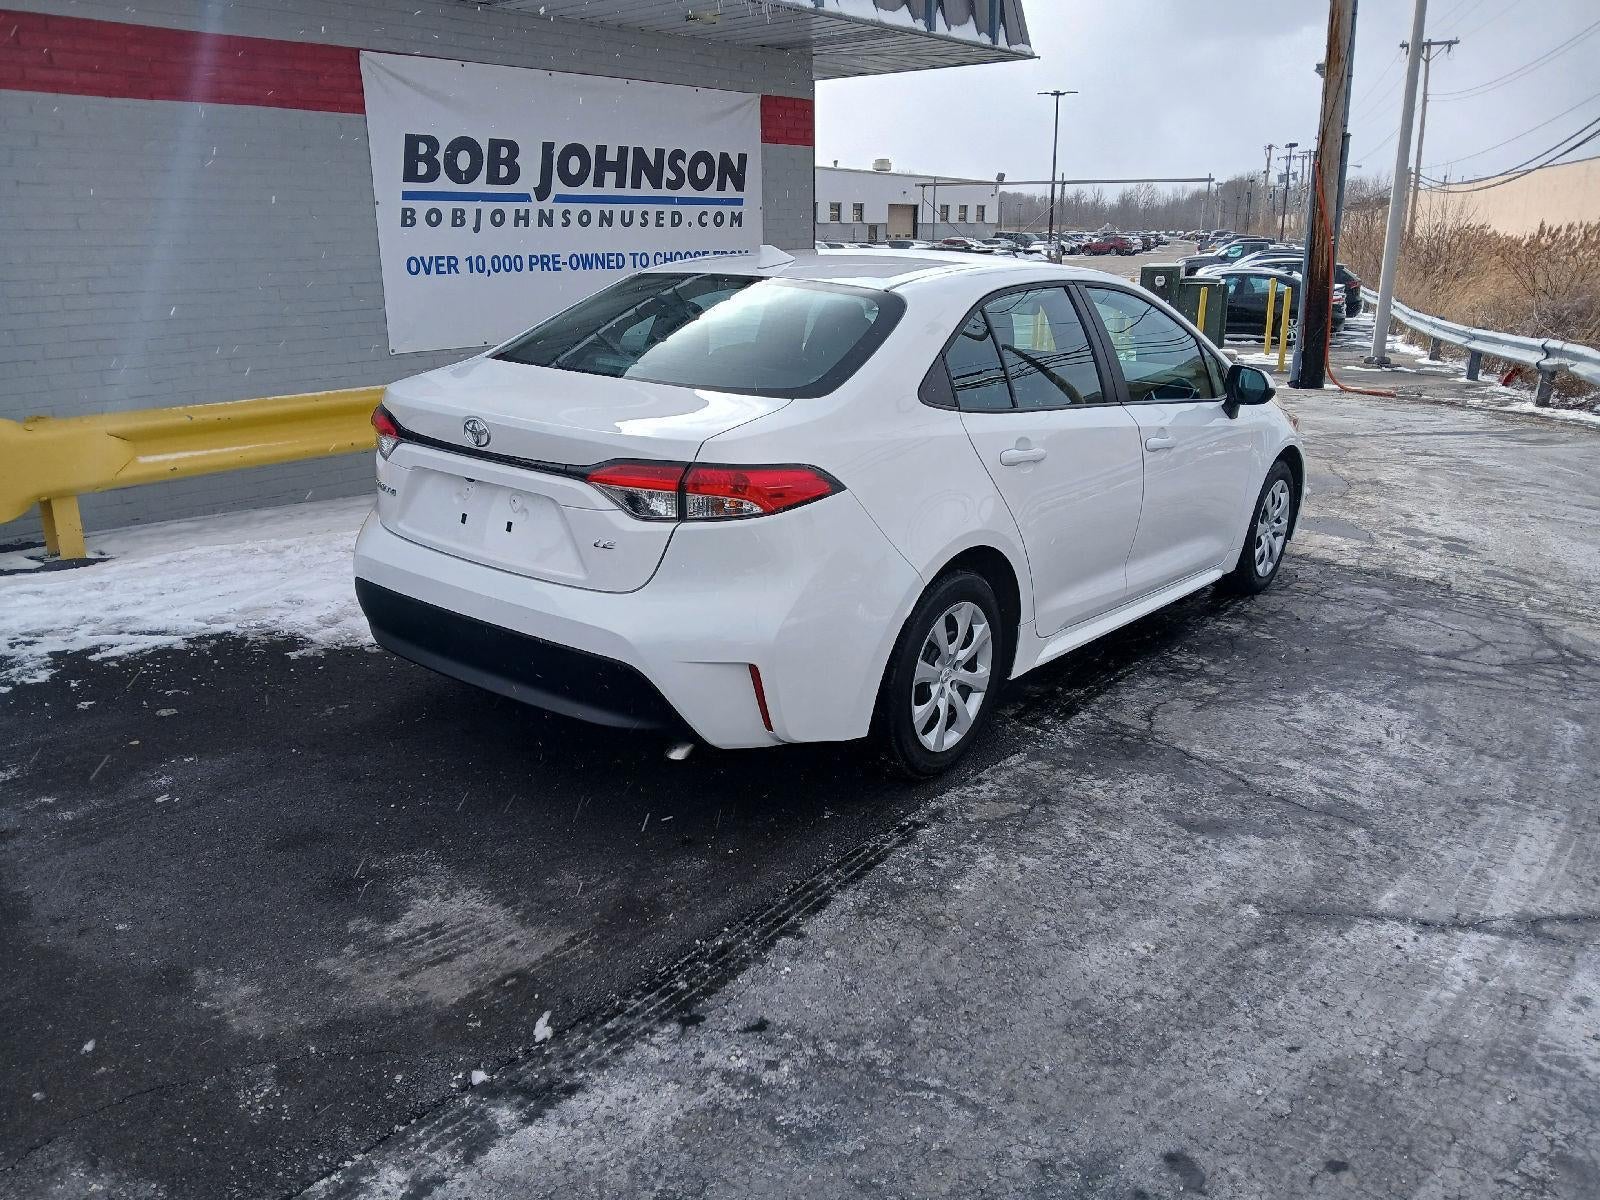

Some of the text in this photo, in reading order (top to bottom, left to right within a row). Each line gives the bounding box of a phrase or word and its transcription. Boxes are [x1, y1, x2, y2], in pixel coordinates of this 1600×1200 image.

[403, 133, 748, 202] BOB JOHNSON
[400, 207, 743, 234] BOBJOHNSONUSED.COM
[406, 255, 460, 276] OVER
[465, 254, 524, 277] 10,000
[528, 252, 626, 272] PRE-OWNED
[629, 251, 650, 269] TO
